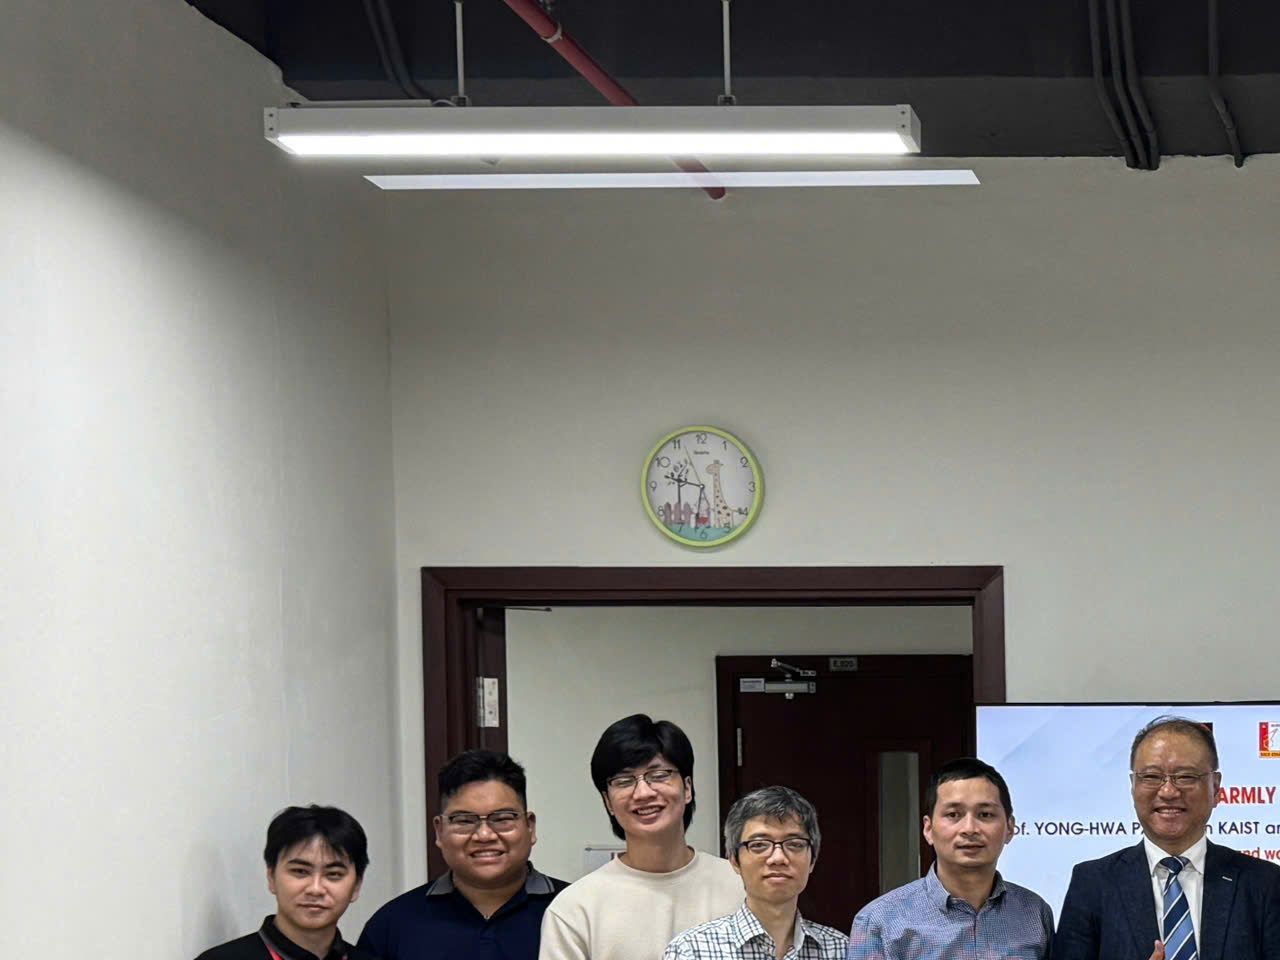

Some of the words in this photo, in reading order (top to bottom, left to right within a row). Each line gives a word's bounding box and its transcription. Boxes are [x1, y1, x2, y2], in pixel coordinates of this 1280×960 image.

[695, 433, 707, 444] 12
[673, 440, 681, 450] 11
[723, 441, 727, 451] 1
[656, 456, 671, 468] 10
[740, 456, 749, 468] 2
[649, 481, 657, 492] 9
[748, 481, 756, 493] 3
[1217, 786, 1277, 804] ARMLY
[1013, 821, 1030, 836] of.
[1034, 821, 1127, 836] YONG-HWA
[1218, 821, 1260, 835] KAIST
